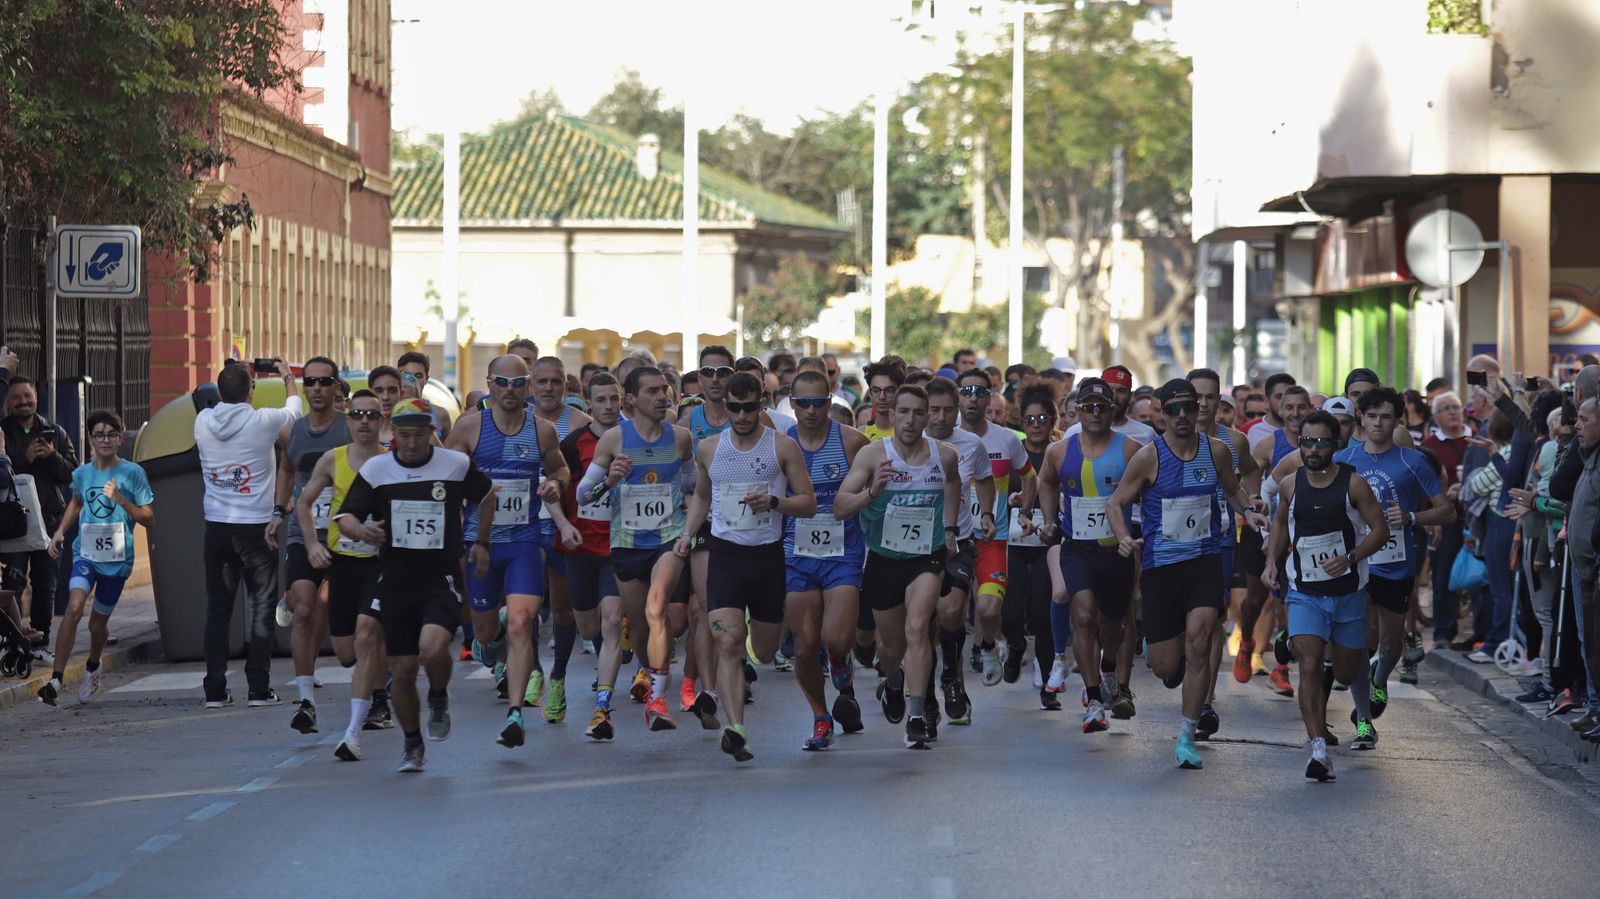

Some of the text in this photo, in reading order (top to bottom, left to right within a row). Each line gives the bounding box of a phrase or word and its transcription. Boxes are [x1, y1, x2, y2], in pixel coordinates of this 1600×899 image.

[495, 496, 523, 512] 140
[635, 500, 666, 518] 160
[404, 518, 437, 536] 155
[1087, 512, 1106, 528] 57
[1186, 513, 1196, 529] 6
[811, 529, 832, 546] 82
[900, 523, 922, 541] 75
[95, 536, 114, 552] 85
